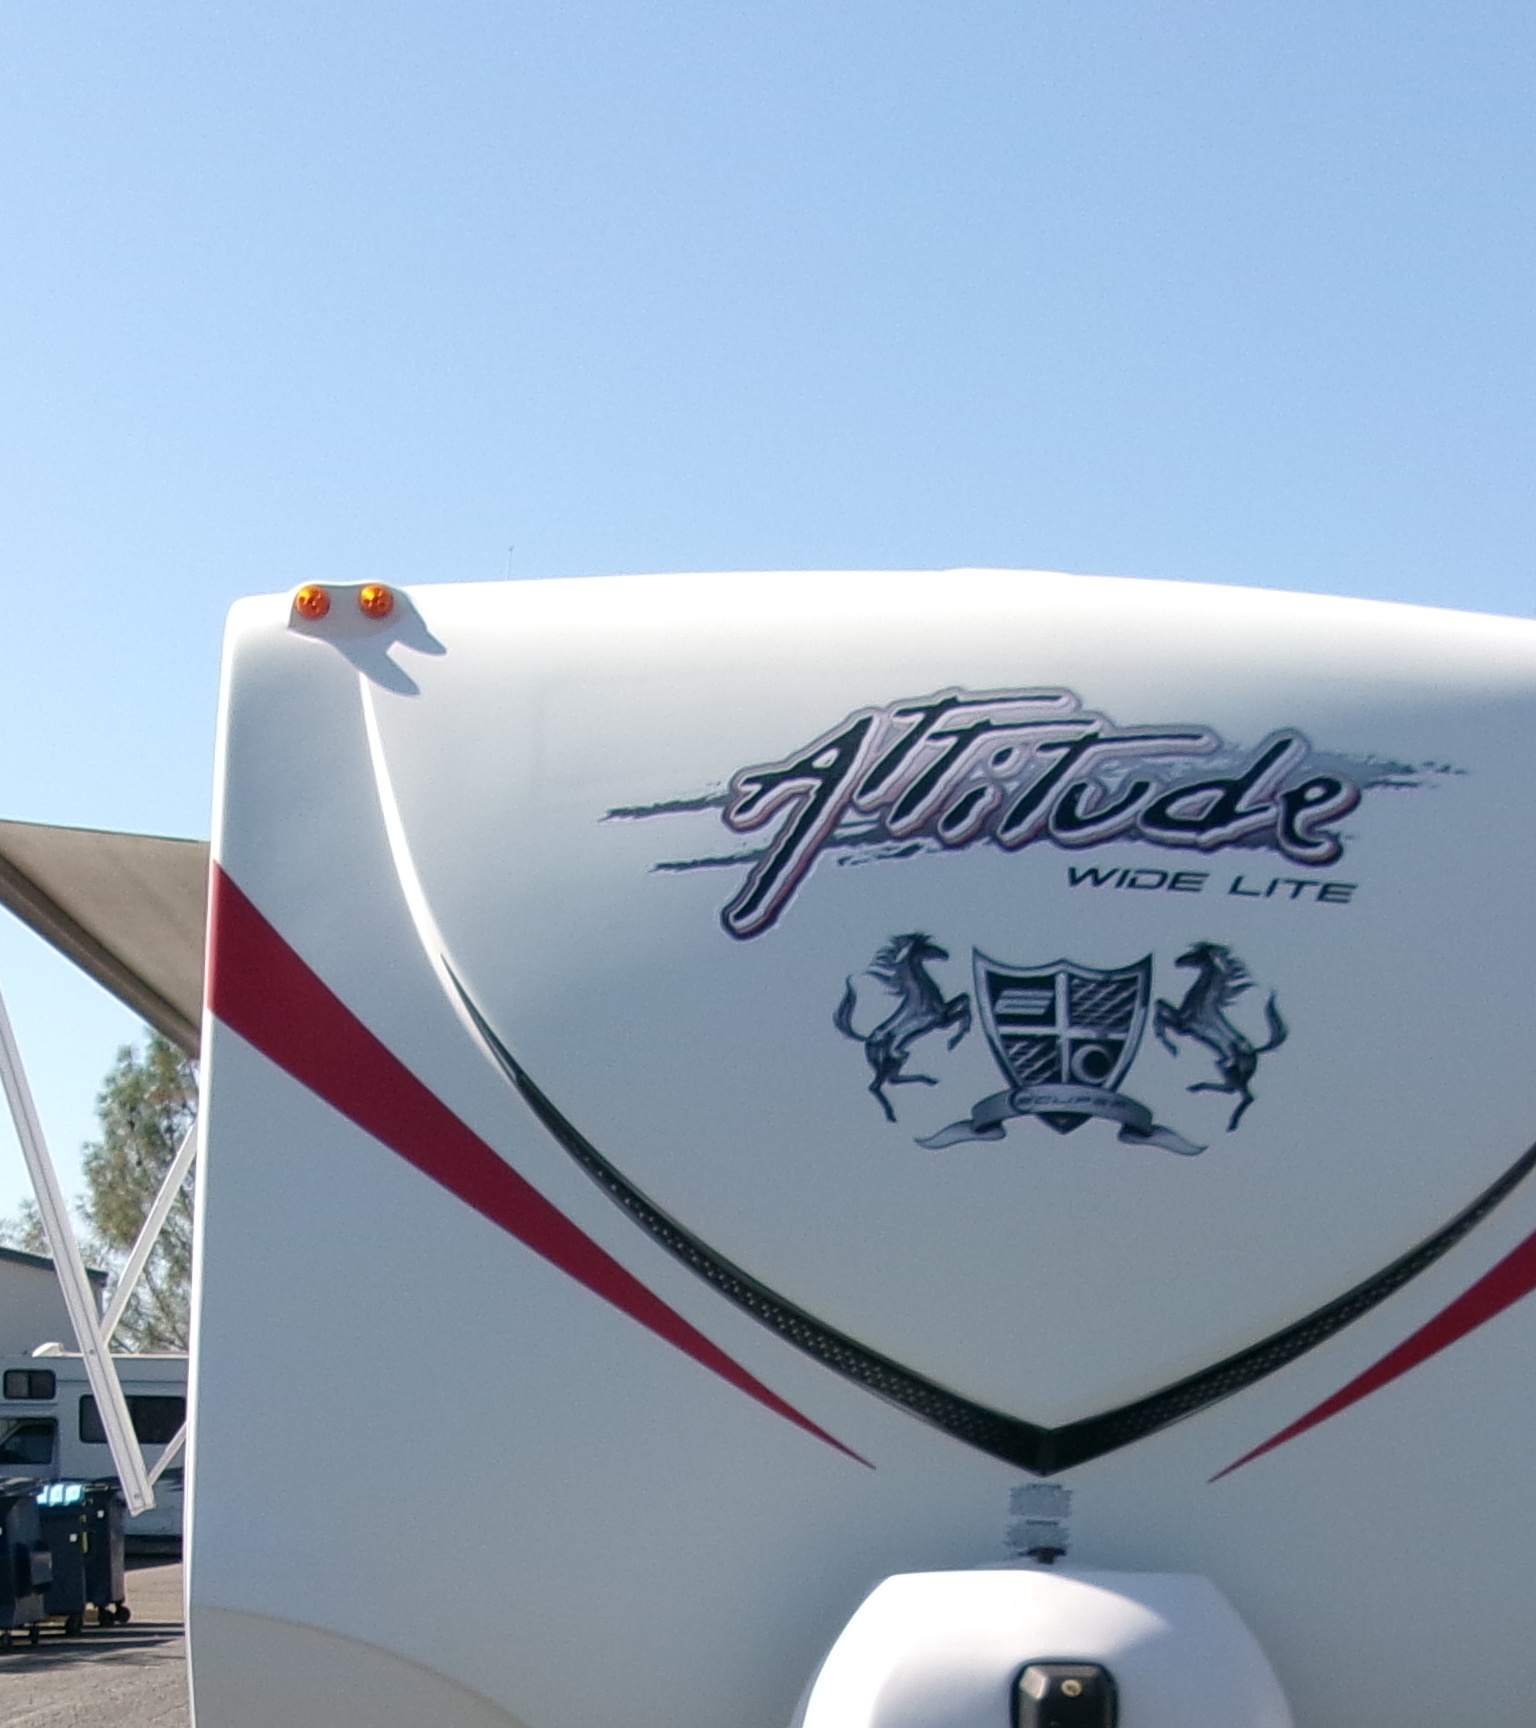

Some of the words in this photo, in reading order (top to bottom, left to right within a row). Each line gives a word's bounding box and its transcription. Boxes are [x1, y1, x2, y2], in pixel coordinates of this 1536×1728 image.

[721, 687, 1362, 940] Attitude
[1067, 866, 1211, 893] WIDE
[1227, 875, 1359, 904] LITE
